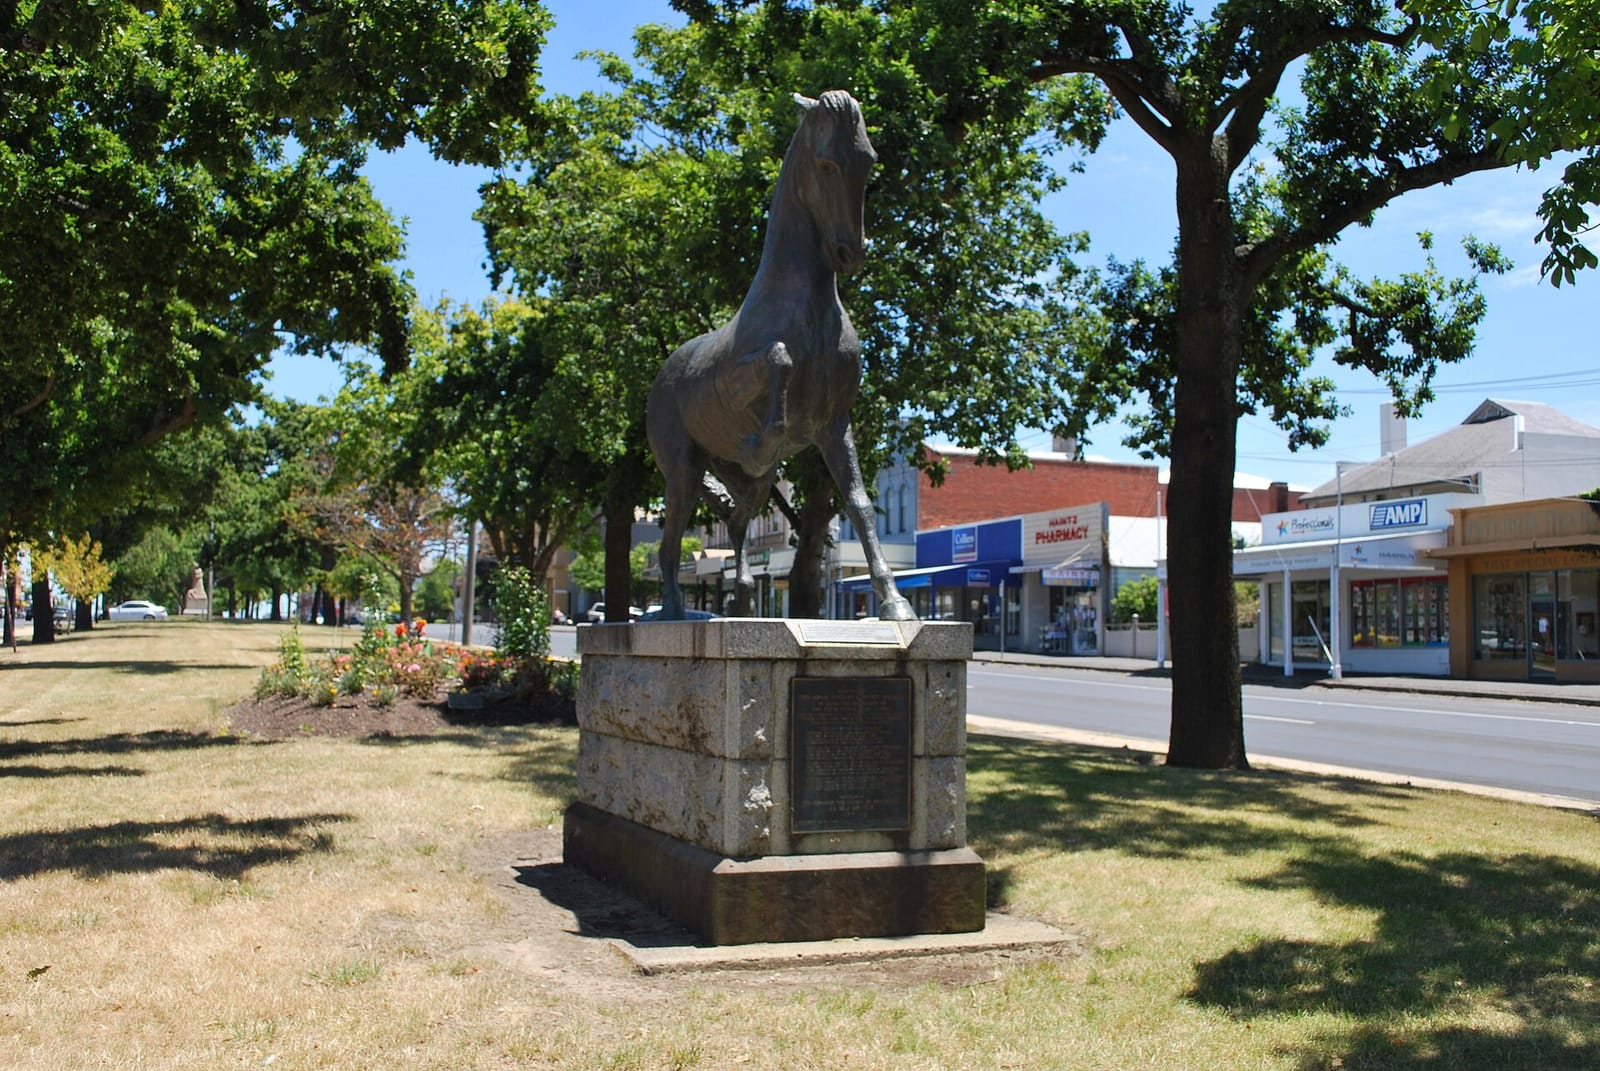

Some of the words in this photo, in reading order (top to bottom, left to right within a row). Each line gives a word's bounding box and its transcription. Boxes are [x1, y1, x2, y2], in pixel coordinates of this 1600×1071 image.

[1384, 502, 1420, 525] AMP
[1291, 515, 1334, 532] Professionals
[1035, 526, 1089, 545] PHARMACY
